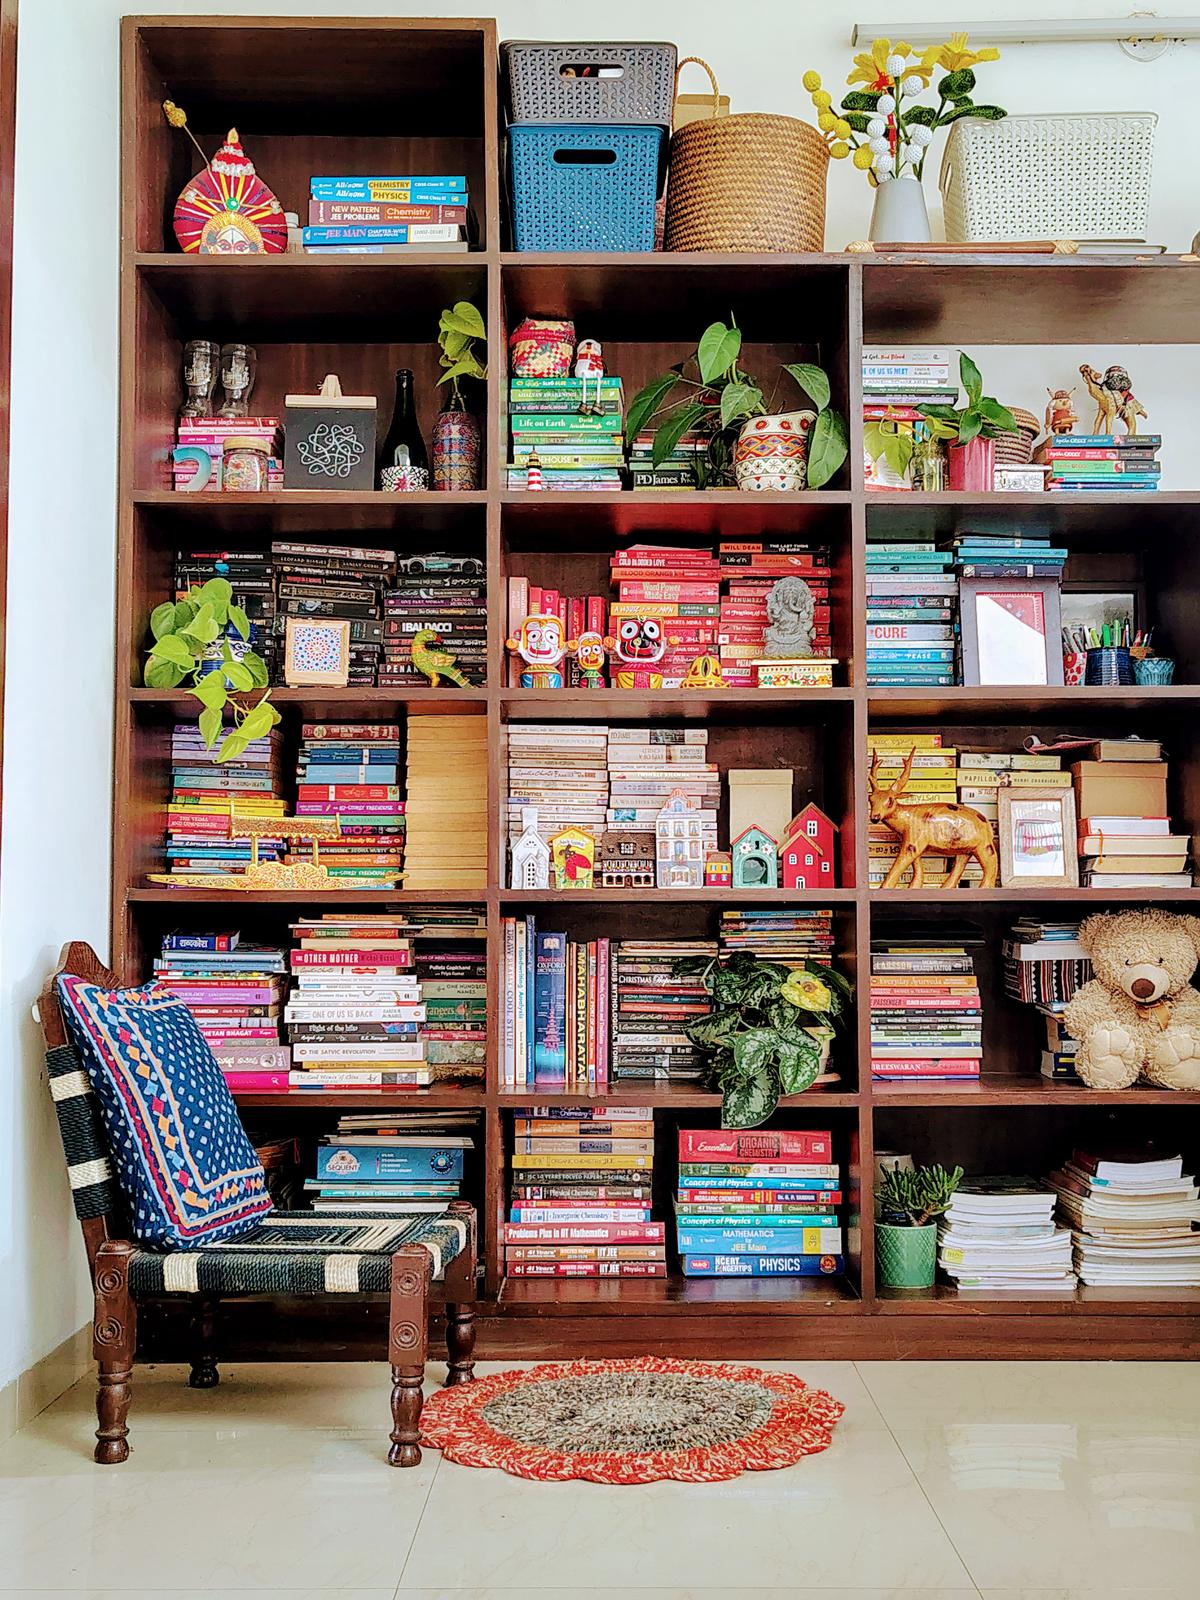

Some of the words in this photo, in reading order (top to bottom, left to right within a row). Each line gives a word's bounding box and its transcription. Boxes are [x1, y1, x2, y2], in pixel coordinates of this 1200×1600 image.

[368, 181, 410, 189] CHEMISTRY
[372, 191, 408, 200] PHYSICS
[331, 205, 349, 213] NEW
[350, 205, 380, 213] PATTERN
[386, 207, 431, 216] Chemistry
[326, 229, 341, 239] JEE
[342, 229, 367, 238] MAIN
[520, 419, 534, 427] Life
[546, 419, 566, 427] Earth
[874, 626, 908, 638] CURE
[304, 954, 327, 963] OTHER
[330, 954, 358, 963] MOTHER
[576, 952, 586, 1075] MAHABHARATA
[697, 1141, 736, 1152] Essential
[739, 1136, 778, 1148] ORGANIC
[740, 1148, 778, 1158] CHEMISTRY
[684, 1178, 718, 1188] Concepts
[718, 1178, 726, 1186] of
[726, 1178, 753, 1188] Physics
[550, 1189, 571, 1197] Physical
[571, 1189, 598, 1198] Chemistry
[552, 1211, 580, 1220] Inorganic
[580, 1211, 610, 1220] Chemistry
[681, 1218, 715, 1226] Concepts
[724, 1218, 751, 1226] Physics
[508, 1228, 538, 1238] Problems
[538, 1228, 552, 1238] Plus
[554, 1228, 560, 1238] in
[570, 1228, 609, 1238] Mathematics
[722, 1230, 774, 1238] MATHEMATICS
[606, 1248, 618, 1257] JEE
[731, 1244, 746, 1252] JEE
[747, 1244, 767, 1252] Main
[608, 1264, 620, 1273] JEE
[623, 1266, 646, 1274] Physics
[715, 1257, 740, 1266] NCERT
[760, 1258, 800, 1272] PHYSICS
